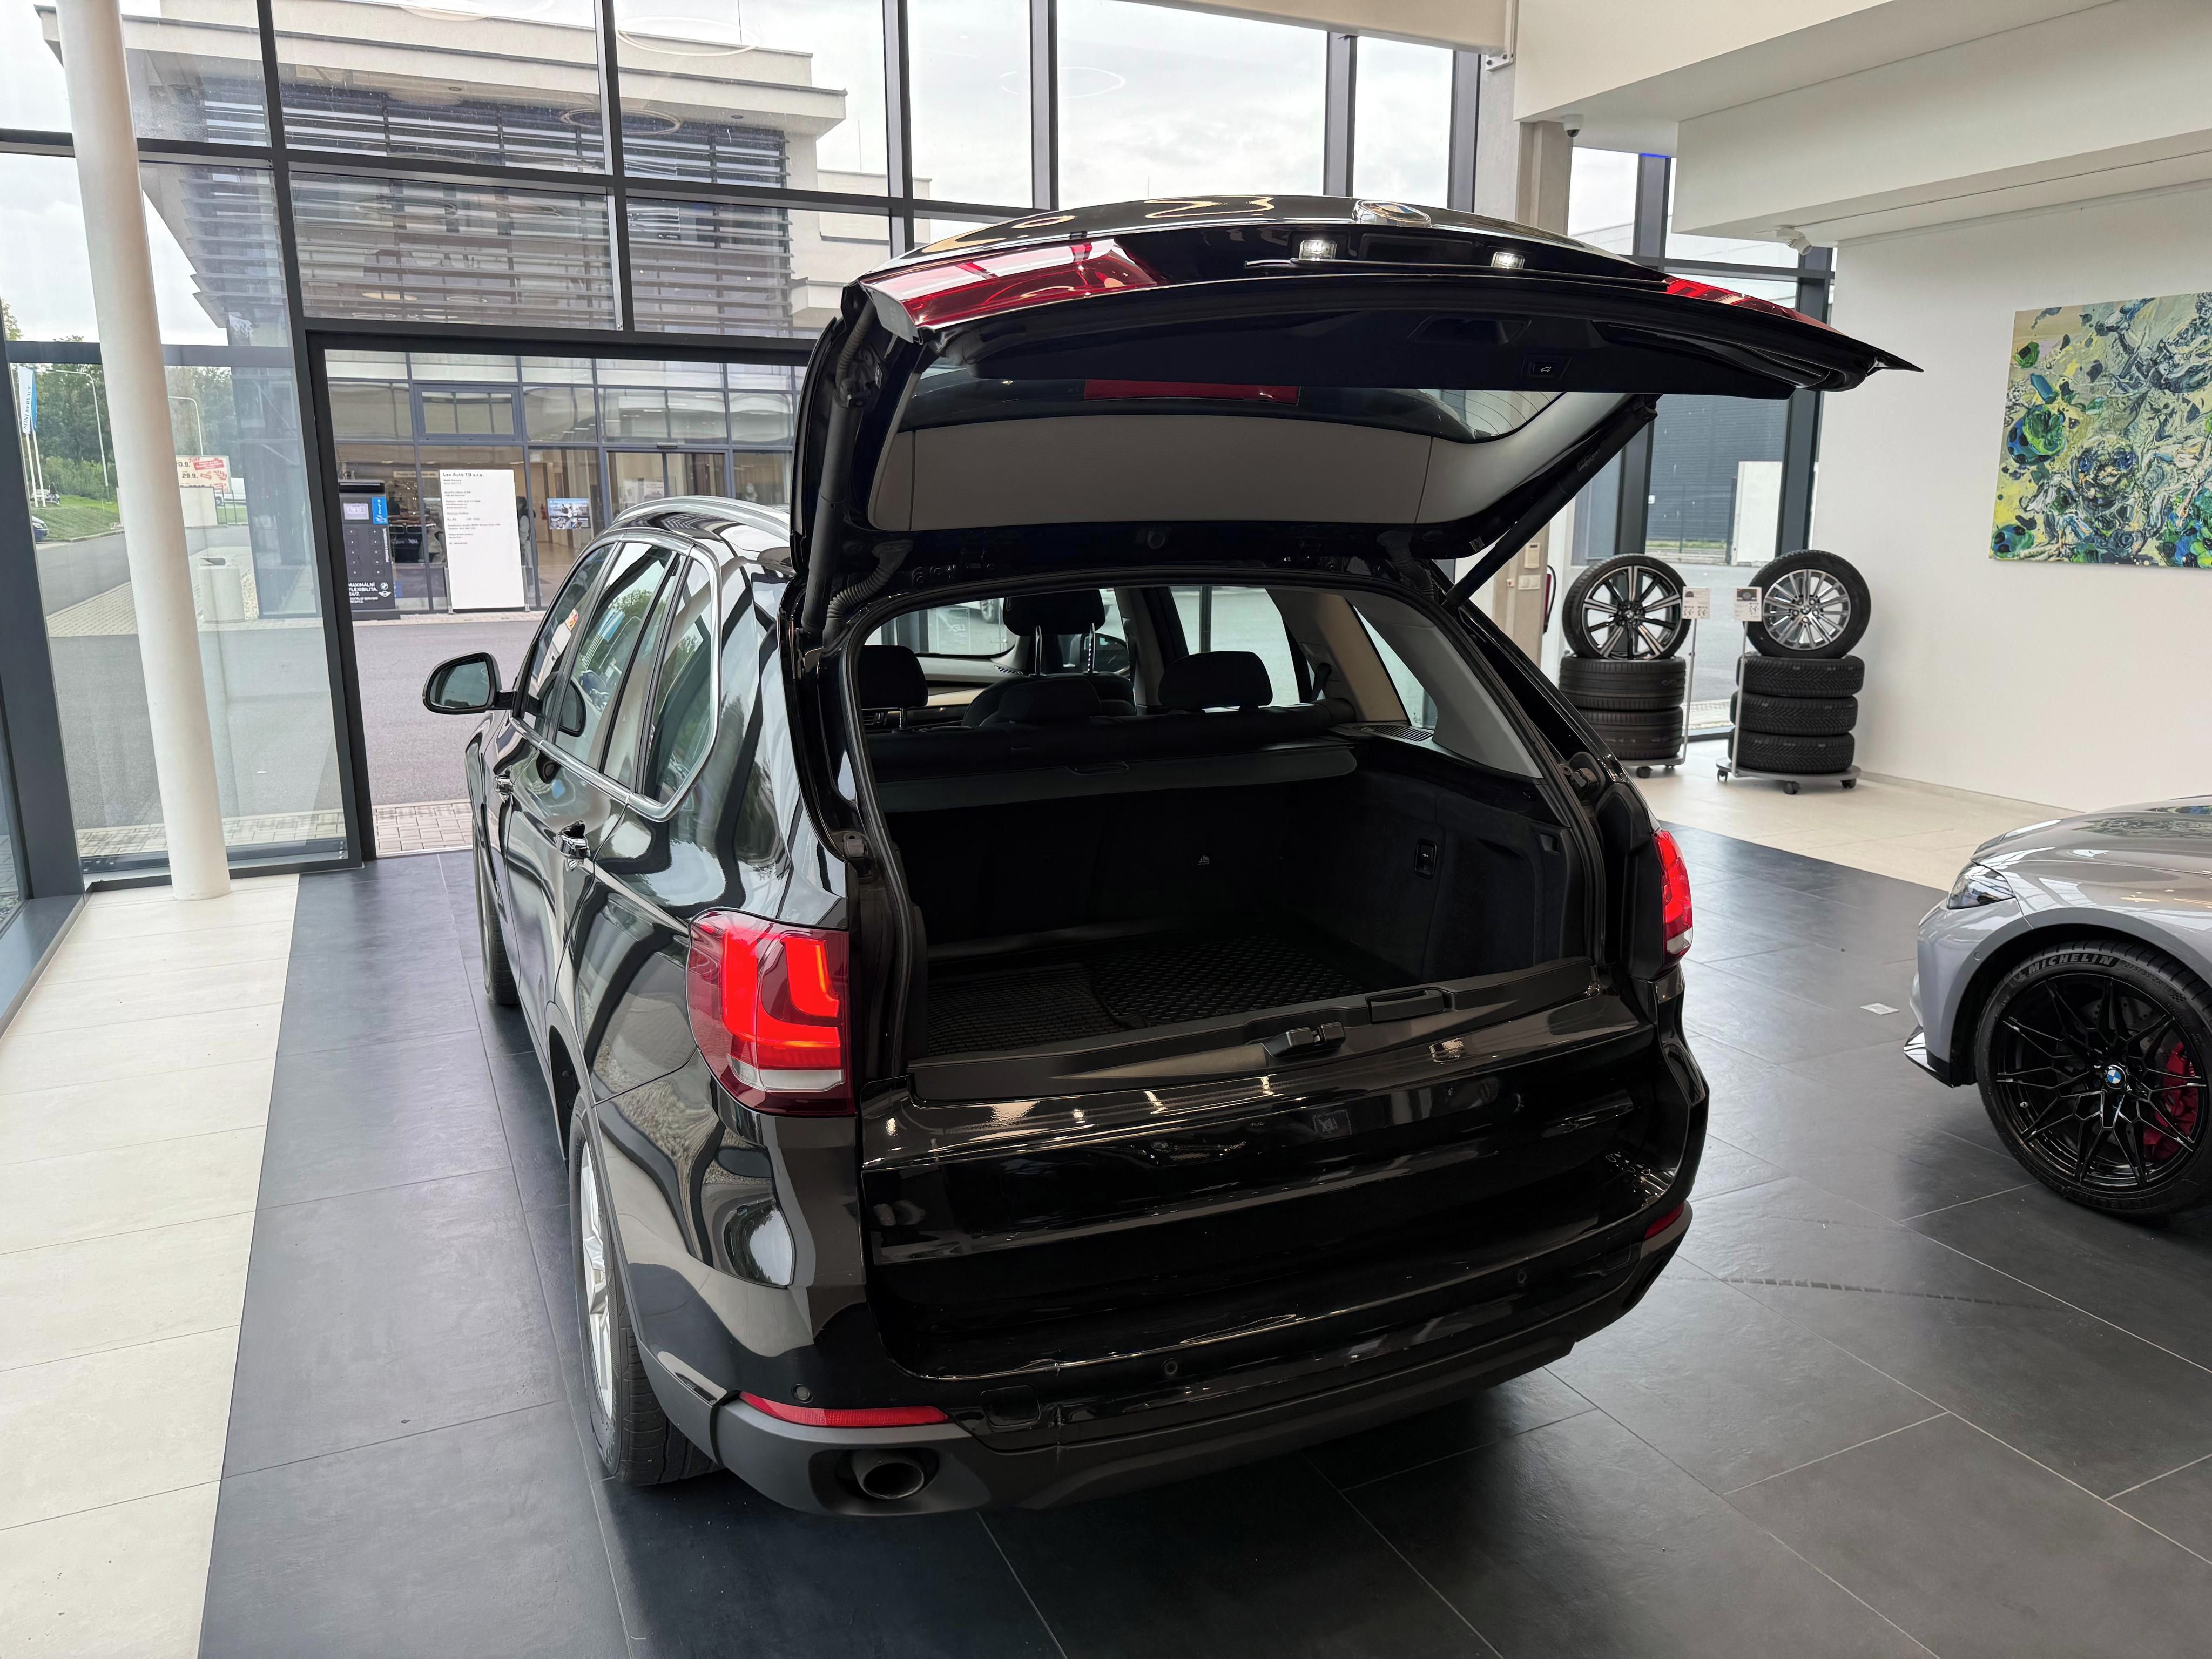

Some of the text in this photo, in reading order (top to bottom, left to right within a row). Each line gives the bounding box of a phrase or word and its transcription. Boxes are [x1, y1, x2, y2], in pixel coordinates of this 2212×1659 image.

[2028, 953, 2114, 974] MICHELIN
[2124, 962, 2152, 978] 275/35
[2152, 976, 2163, 986] ZR
